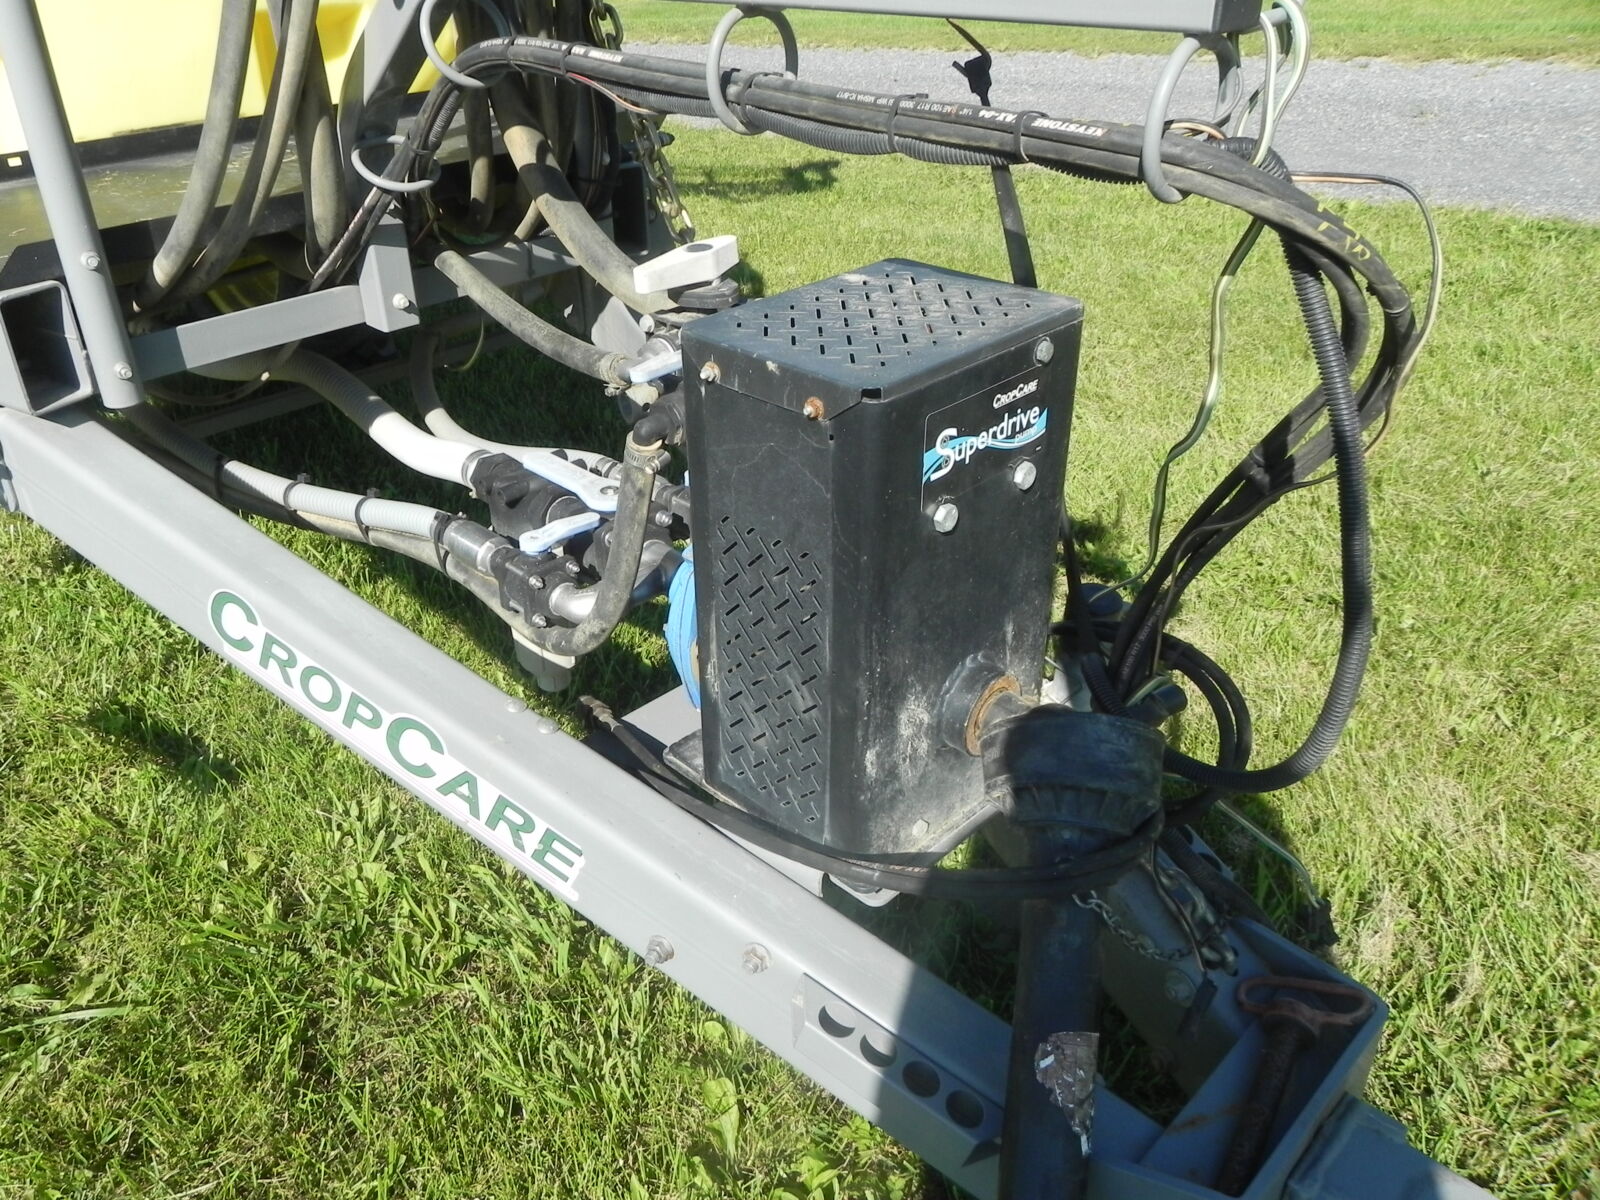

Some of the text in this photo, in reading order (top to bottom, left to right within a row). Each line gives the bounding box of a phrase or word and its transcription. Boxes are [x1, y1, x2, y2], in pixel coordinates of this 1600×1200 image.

[978, 109, 1018, 123] AX-04
[1031, 118, 1108, 136] KEYSTONE
[1014, 425, 1038, 443] pump
[930, 406, 1040, 482] Superdrive
[210, 591, 583, 882] CROPCARE
